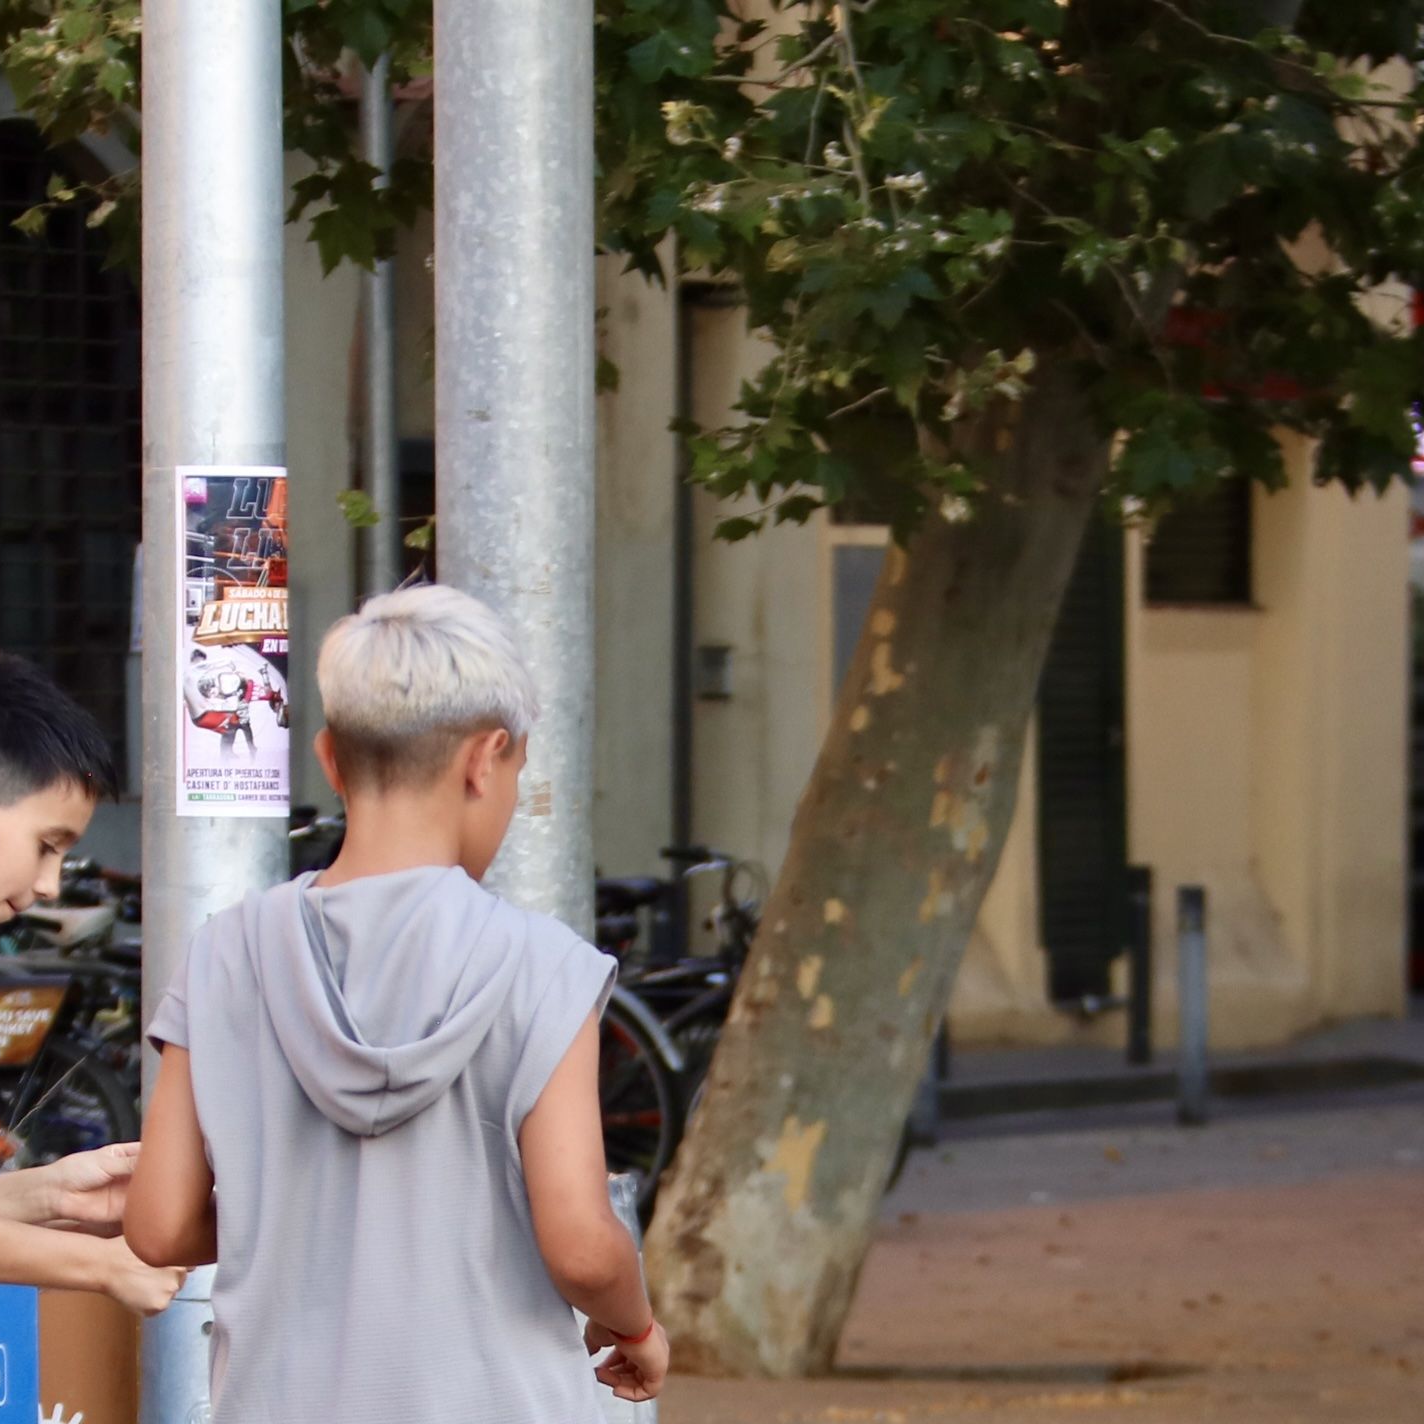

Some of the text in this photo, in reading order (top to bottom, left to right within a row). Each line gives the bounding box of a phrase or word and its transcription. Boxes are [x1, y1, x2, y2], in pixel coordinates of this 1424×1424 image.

[196, 602, 282, 635] LUCHA
[186, 768, 223, 777] APERTURA
[186, 781, 221, 790] CASINET
[234, 781, 280, 790] HOSTAFRANCS
